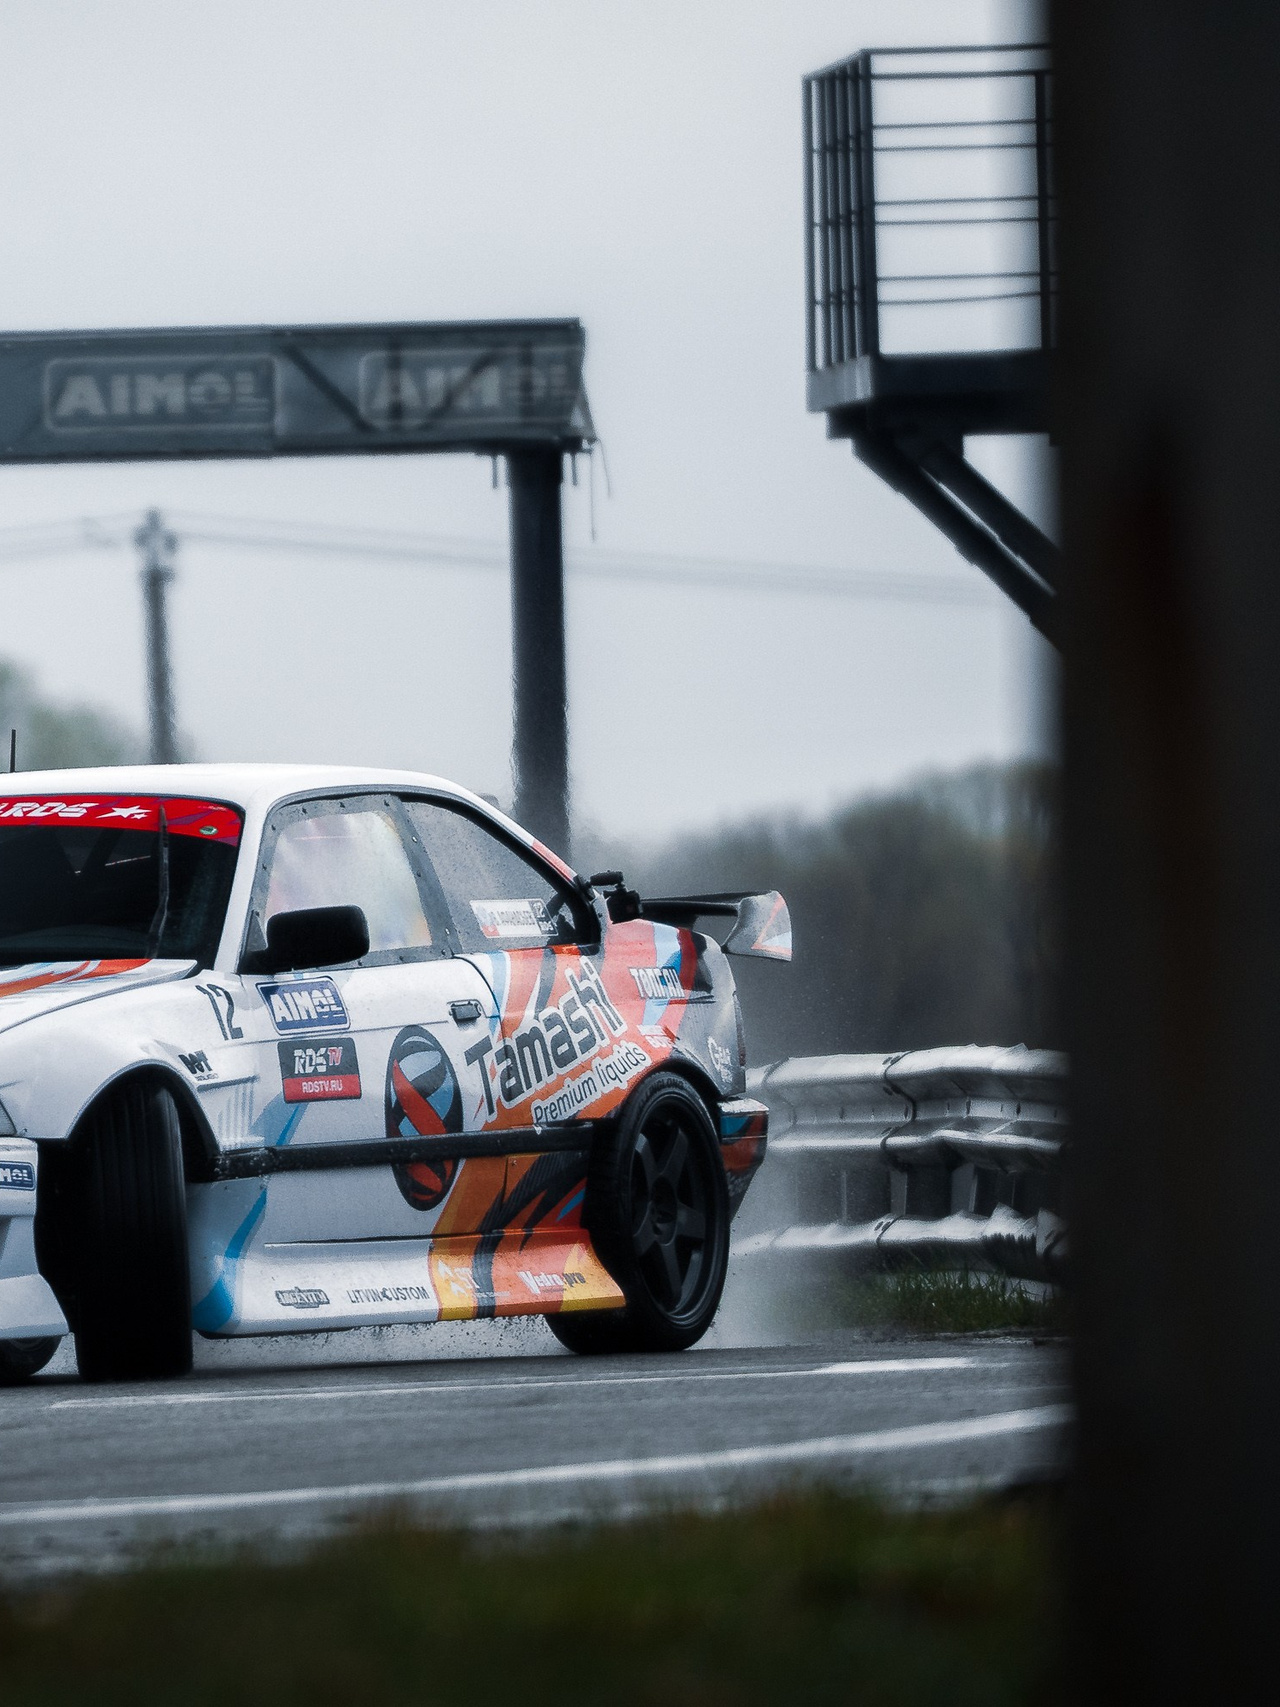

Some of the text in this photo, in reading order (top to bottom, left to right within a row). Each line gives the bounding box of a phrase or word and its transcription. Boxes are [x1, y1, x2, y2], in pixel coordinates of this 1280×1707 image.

[55, 370, 270, 417] AIMOL
[0, 802, 99, 818] RDS
[195, 983, 244, 1040] 12
[270, 988, 345, 1023] AIMOL
[464, 960, 624, 1117] Tamashi
[302, 1079, 343, 1094] RDSTV.RU
[533, 1046, 647, 1125] Premium liquids
